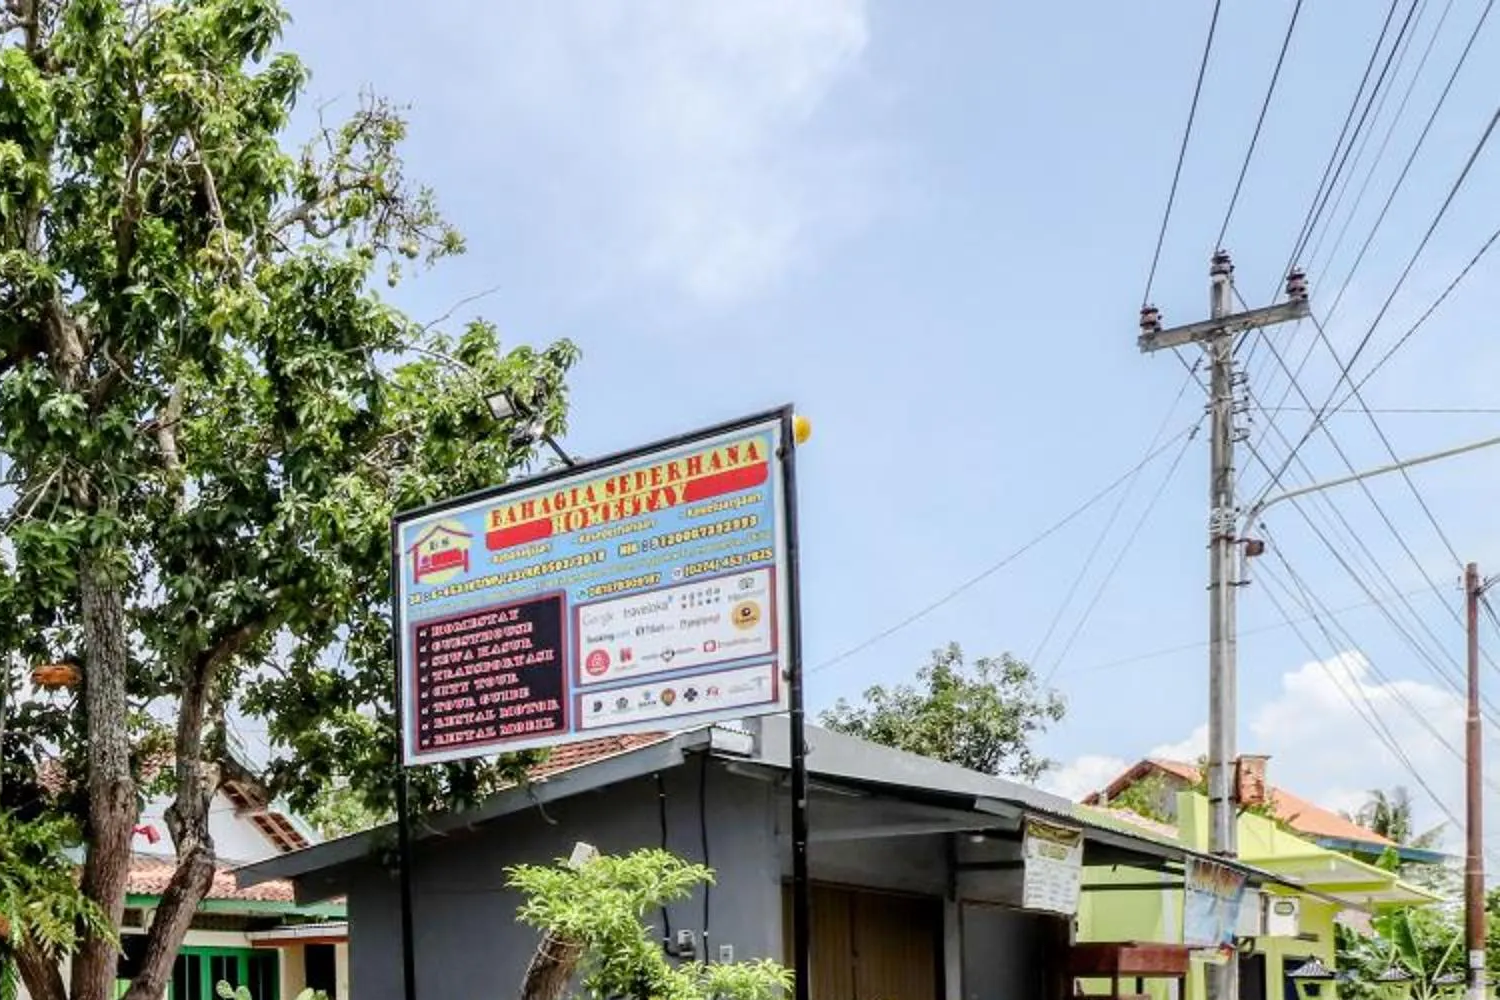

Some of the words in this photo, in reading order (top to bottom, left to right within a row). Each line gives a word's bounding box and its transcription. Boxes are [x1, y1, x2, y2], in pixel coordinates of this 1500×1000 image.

[552, 484, 687, 534] HOMESTAY
[431, 609, 519, 637] HOMESTAY
[474, 673, 519, 690] TOUR
[433, 697, 476, 713] TOUR
[500, 699, 560, 718] MOTOR
